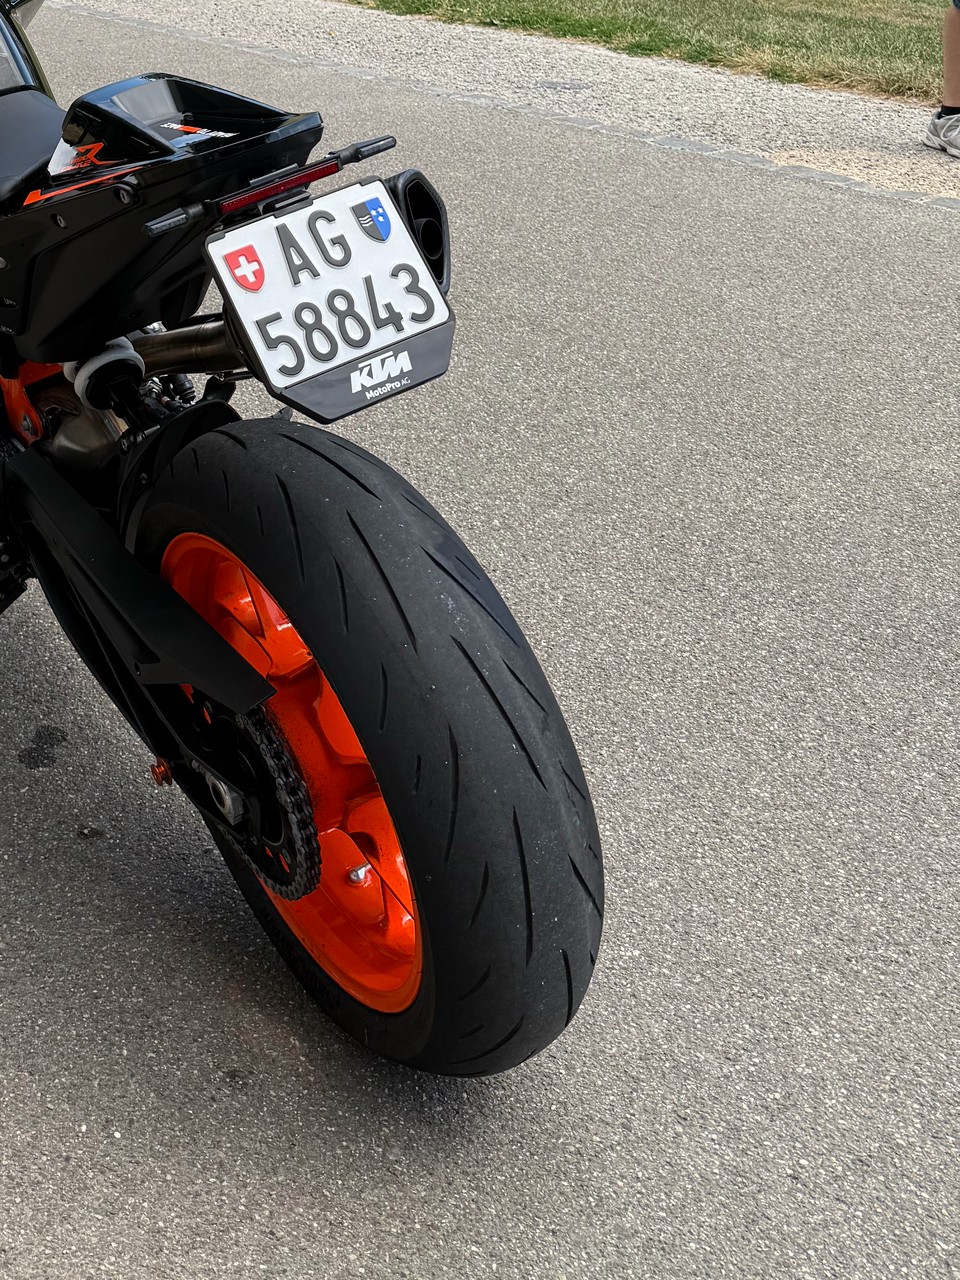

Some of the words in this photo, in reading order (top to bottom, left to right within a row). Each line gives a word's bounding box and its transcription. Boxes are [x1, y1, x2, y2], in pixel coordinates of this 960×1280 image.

[274, 210, 352, 286] AG
[255, 263, 435, 376] 58843
[350, 350, 413, 394] KTM
[365, 381, 401, 400] MotoPro
[401, 376, 411, 386] AG
